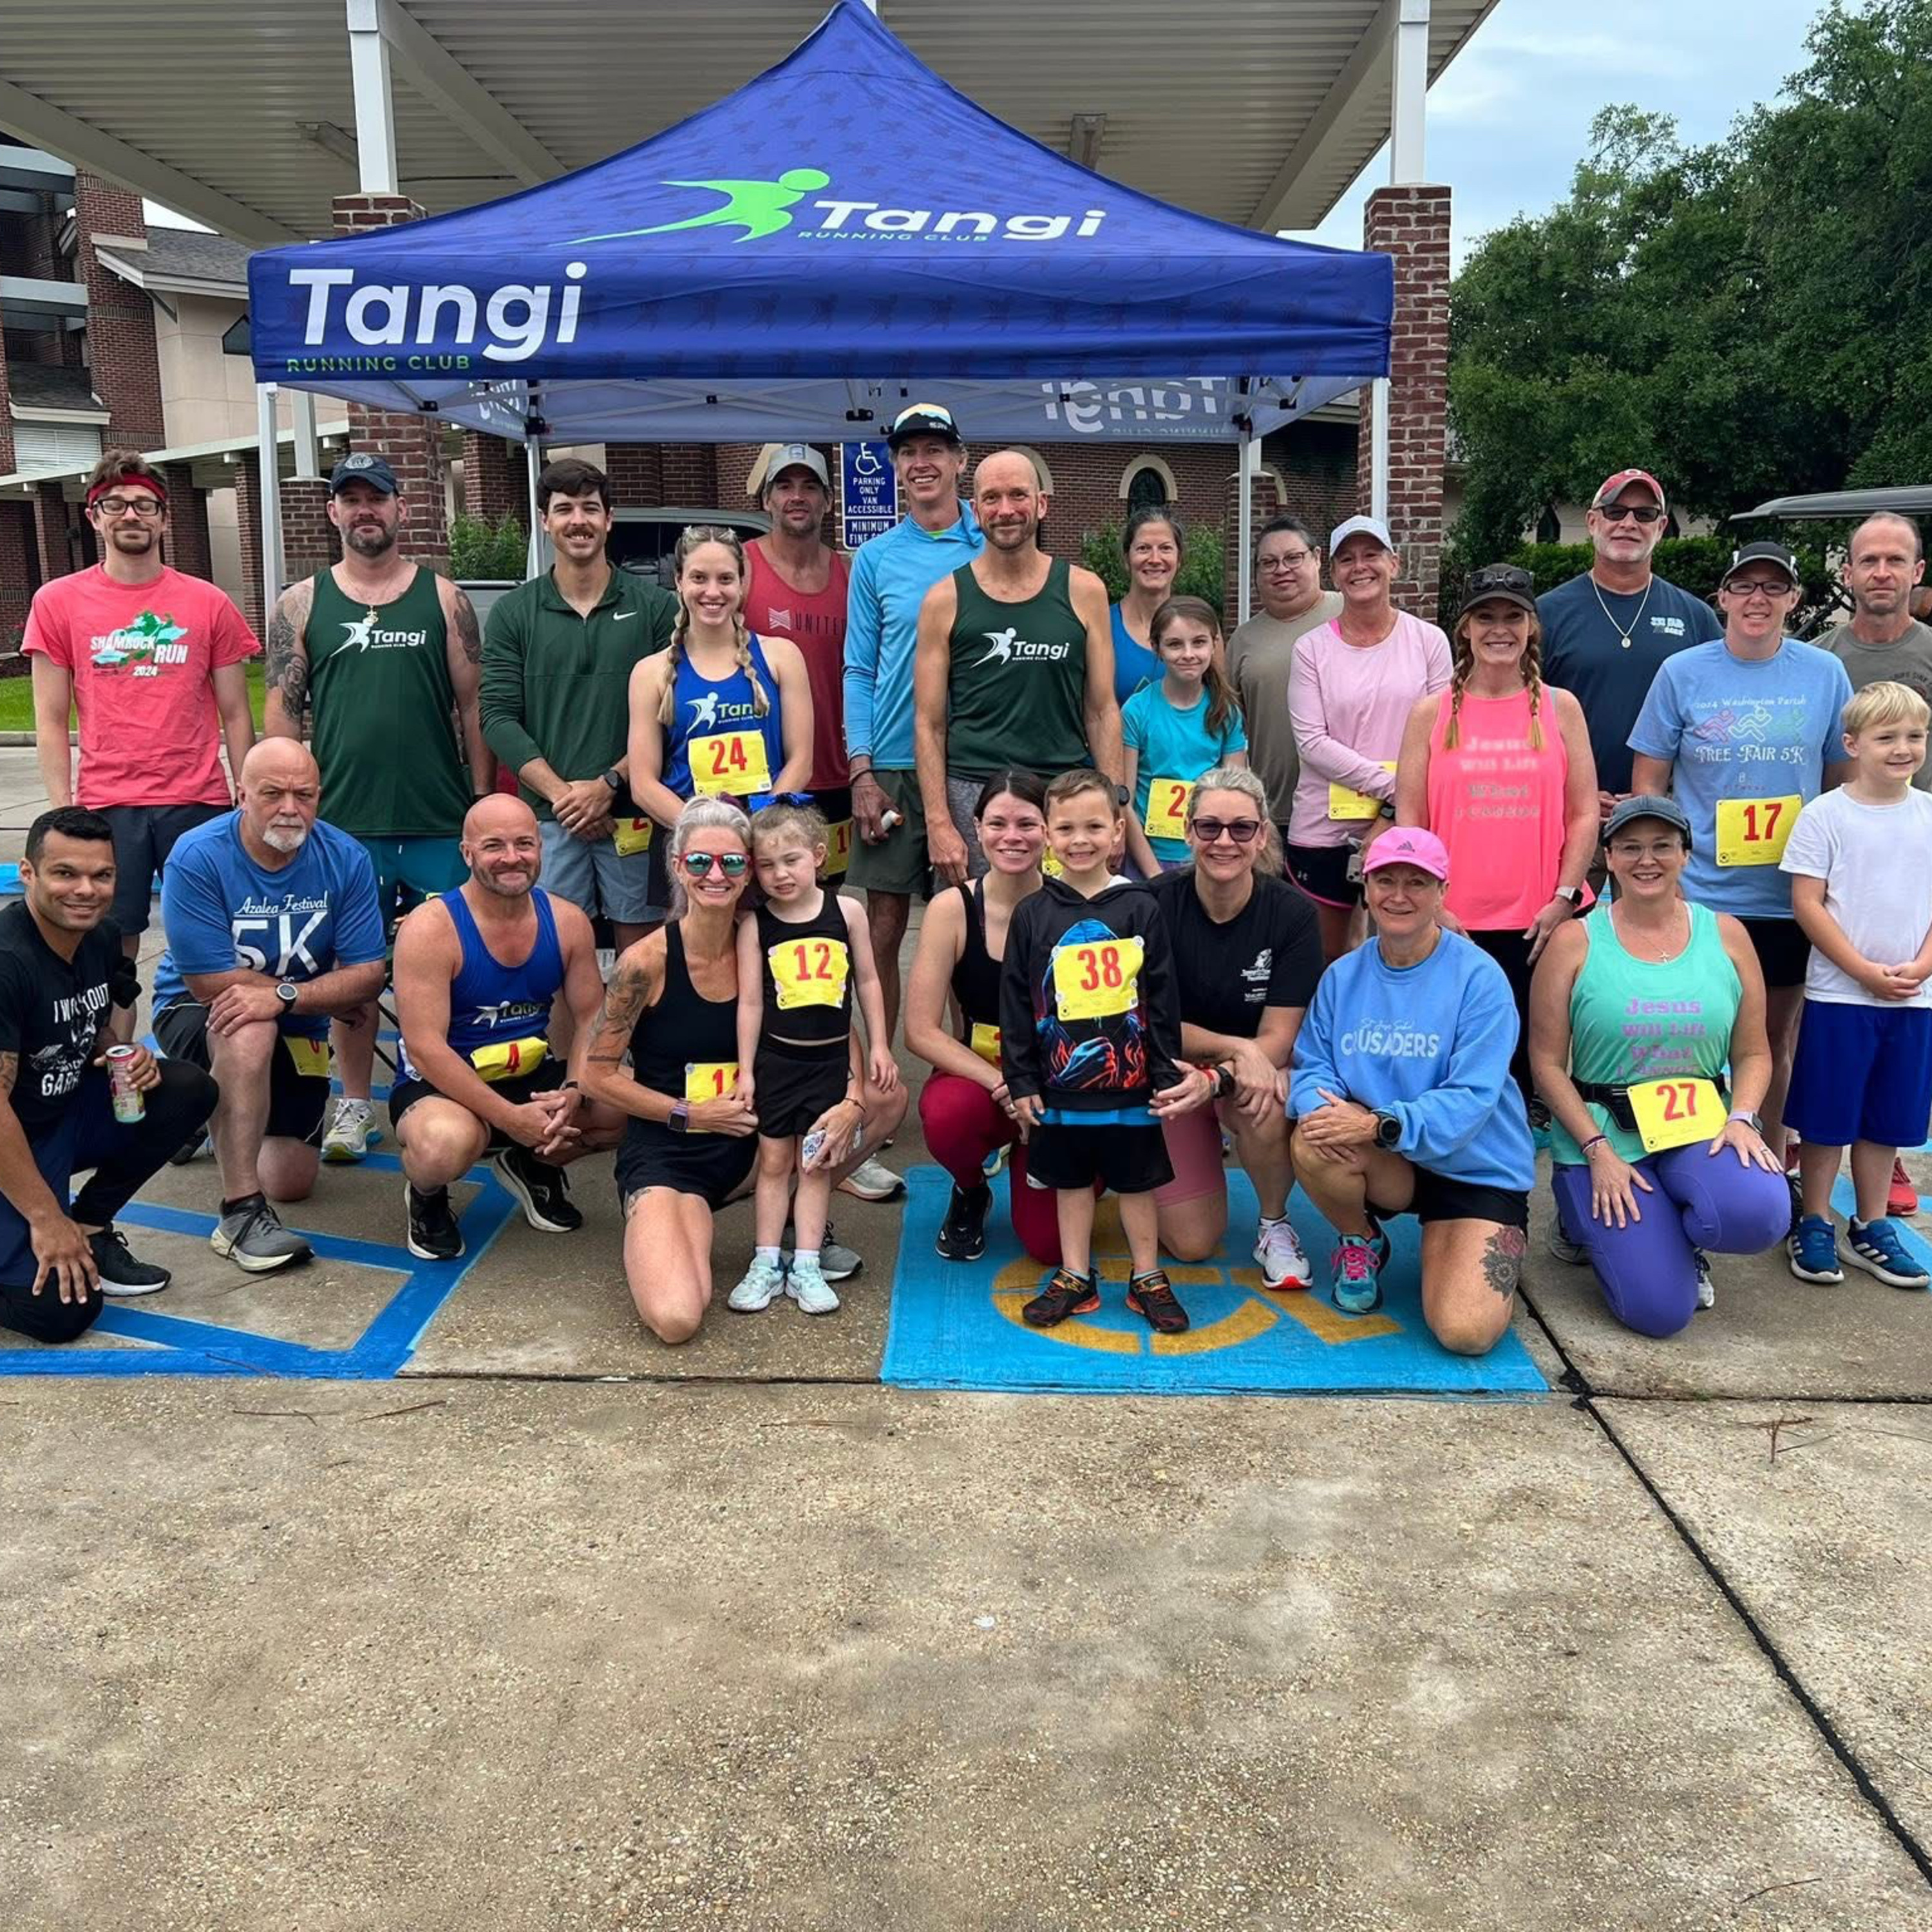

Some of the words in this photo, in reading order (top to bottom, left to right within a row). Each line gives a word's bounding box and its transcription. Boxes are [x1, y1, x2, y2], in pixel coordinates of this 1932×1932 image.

[814, 200, 1106, 241] Tangi
[797, 231, 912, 240] RUNNING
[289, 261, 587, 362] Tangi
[287, 357, 397, 372] RUNNING
[408, 355, 469, 370] CLUB
[853, 477, 886, 486] PARKING
[859, 486, 879, 495] ONLY
[848, 506, 893, 514] ACCESSIBLE
[851, 520, 889, 532] MINIMUM
[849, 533, 869, 544] FINE
[371, 630, 426, 646] Tangi
[90, 636, 155, 650] SHAMROCK
[154, 645, 188, 664] RUN
[1013, 641, 1070, 660] Tangi
[133, 666, 158, 676] 2024
[1777, 694, 1806, 705] Parish
[708, 737, 747, 775] 24
[1737, 744, 1776, 762] FAIR
[1781, 746, 1806, 765] 5K
[1743, 803, 1782, 840] 17
[234, 896, 279, 914] Azalea
[283, 890, 328, 911] Festival
[232, 911, 328, 976] 5K
[794, 943, 832, 981] 12
[1077, 947, 1122, 990] 38
[1625, 998, 1701, 1014] Jesus
[506, 1043, 520, 1074] 4
[1656, 1083, 1696, 1121] 27
